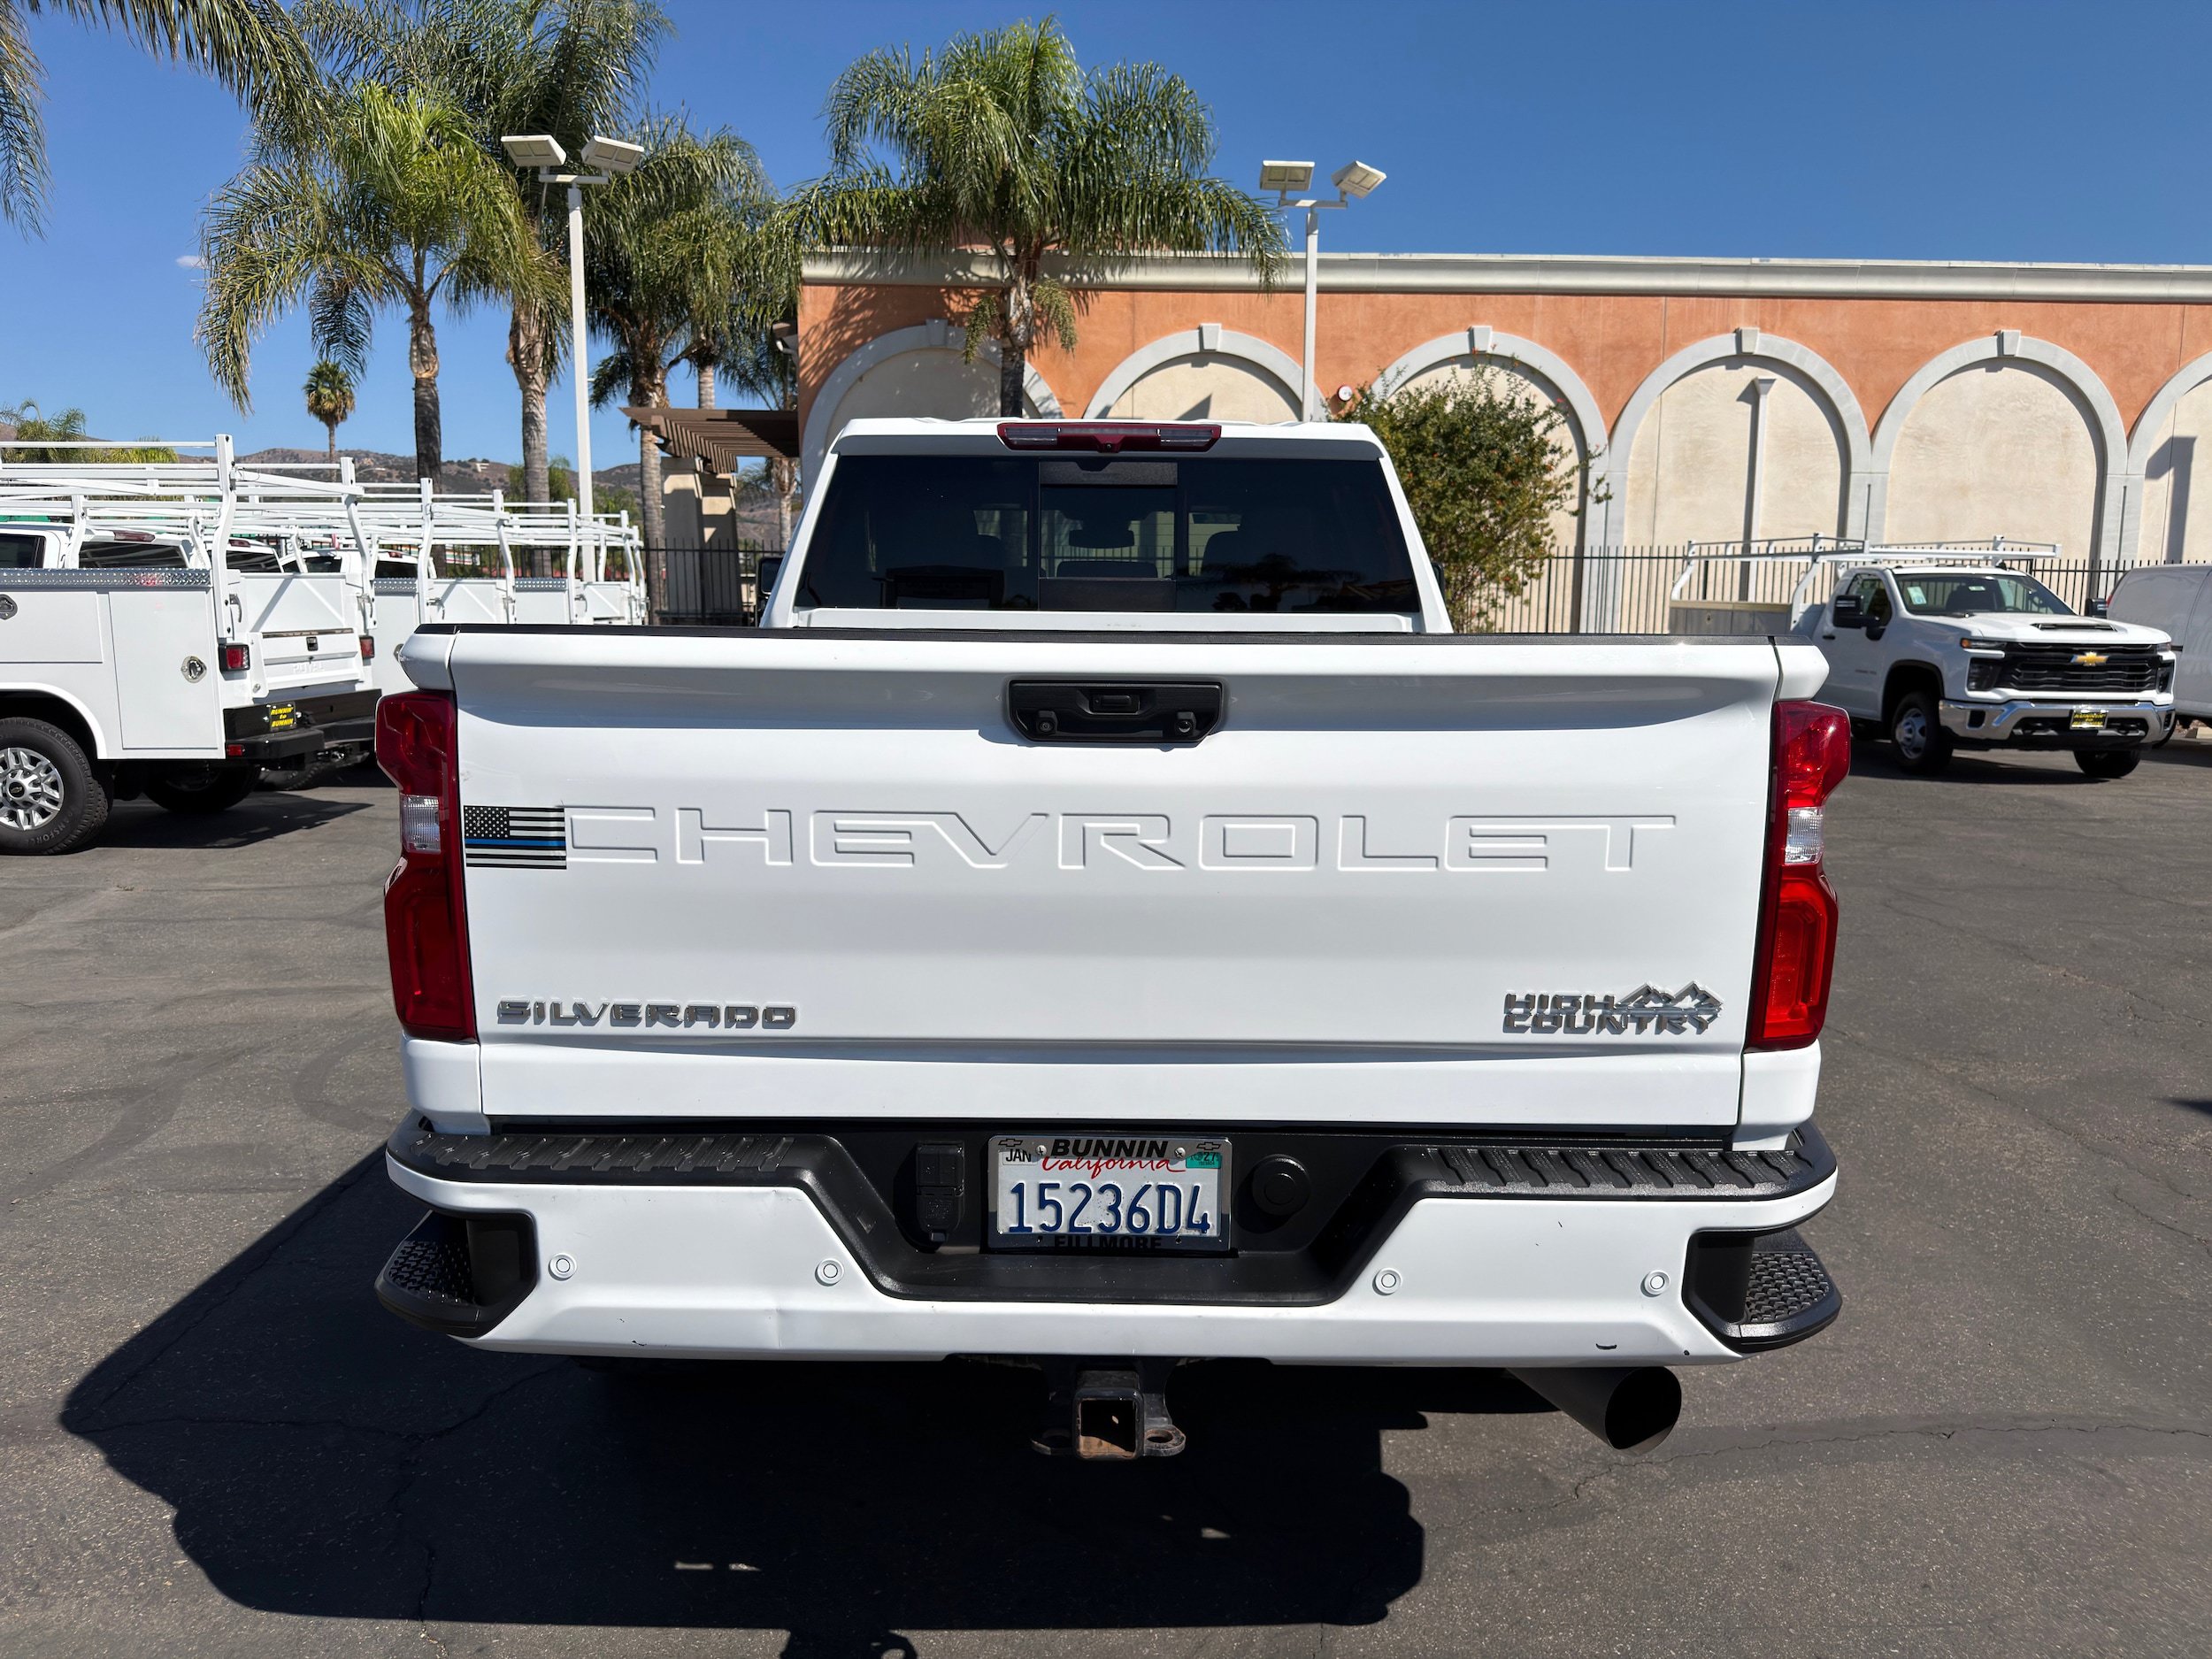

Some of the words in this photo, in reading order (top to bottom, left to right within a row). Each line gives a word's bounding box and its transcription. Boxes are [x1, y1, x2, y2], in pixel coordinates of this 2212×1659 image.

[561, 805, 1677, 873] CHEVROLET
[497, 1000, 795, 1029] SILVERADO
[1504, 993, 1617, 1015] HIGH
[1503, 1014, 1720, 1034] COUNTRY
[1005, 1148, 1032, 1163] JAN
[1050, 1139, 1168, 1158] BUNNIN
[1203, 1152, 1217, 1162] 27
[1041, 1156, 1187, 1179] California
[1009, 1181, 1211, 1234] 15236D4
